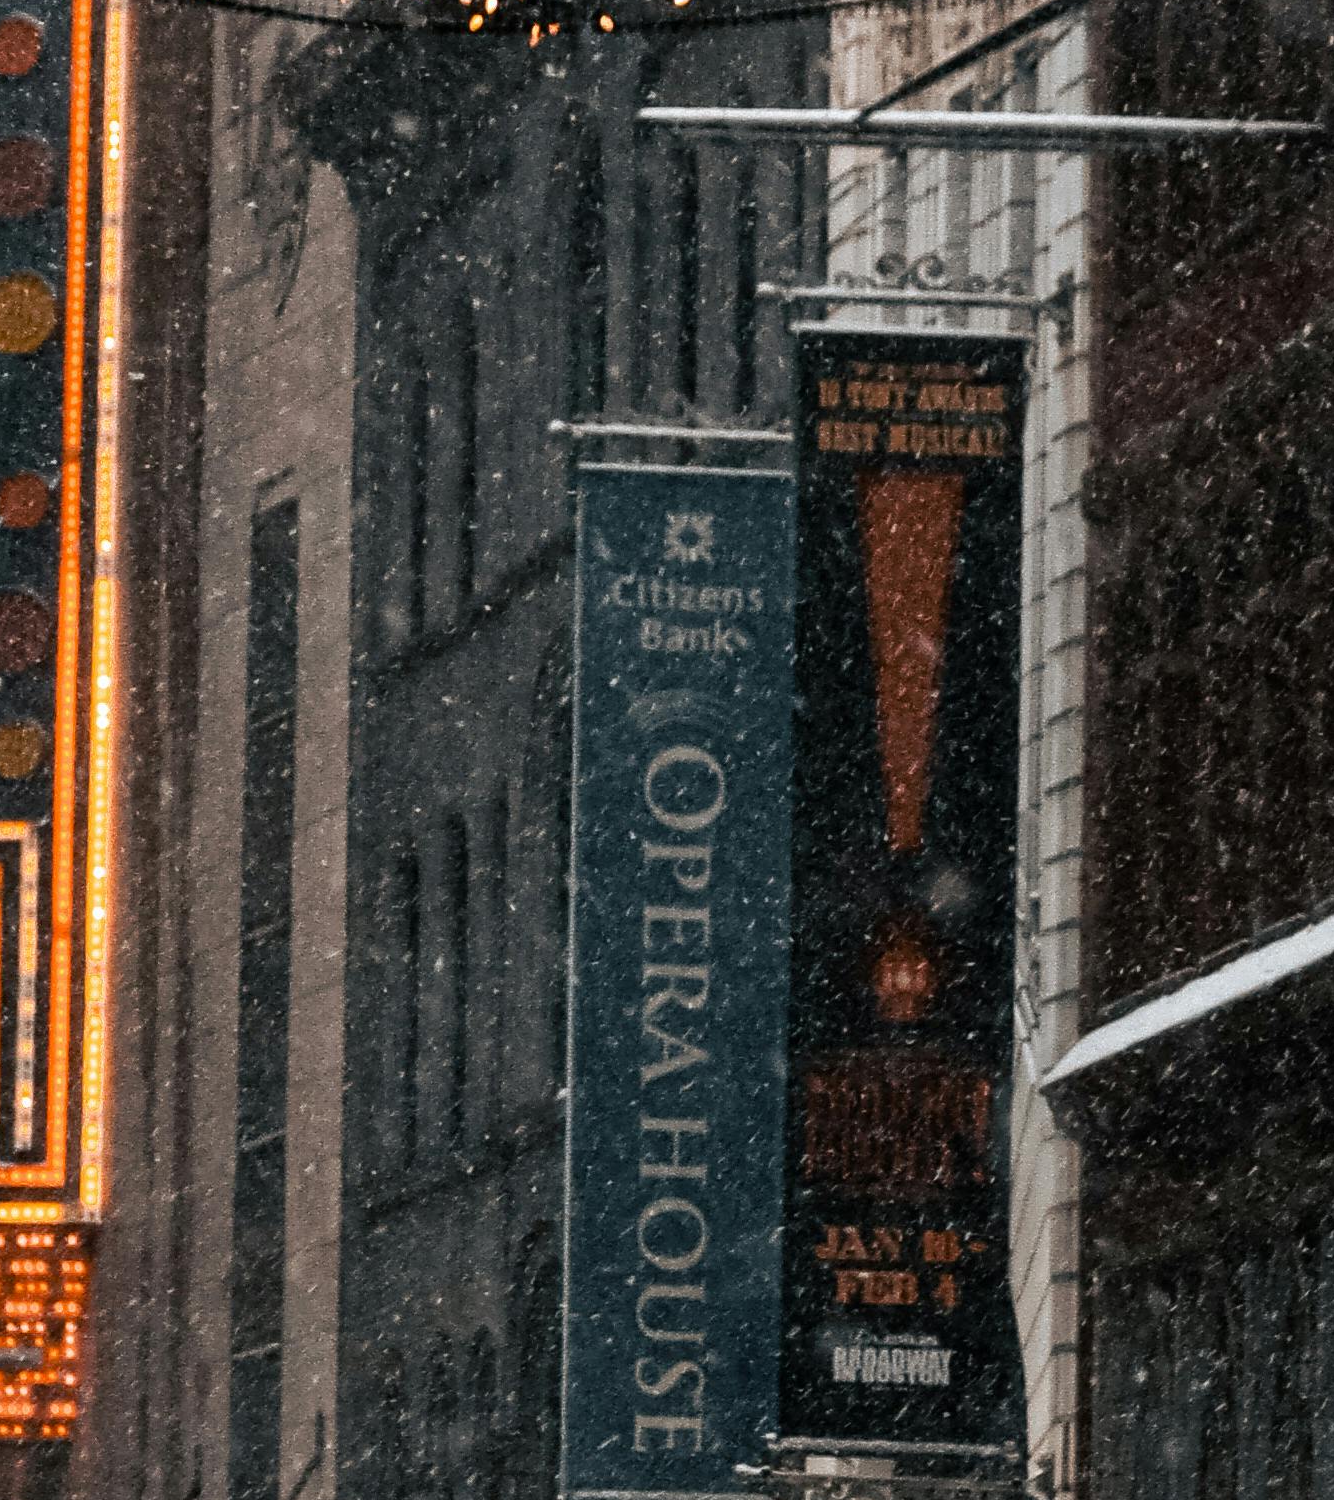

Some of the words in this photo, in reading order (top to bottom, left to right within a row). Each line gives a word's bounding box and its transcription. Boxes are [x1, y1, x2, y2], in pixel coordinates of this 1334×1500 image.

[611, 573, 764, 613] Citizens
[640, 618, 744, 653] Bank
[639, 745, 725, 1090] OPERA
[816, 1225, 903, 1261] JAN
[632, 1116, 709, 1453] HOUSE
[835, 1270, 919, 1305] FEB
